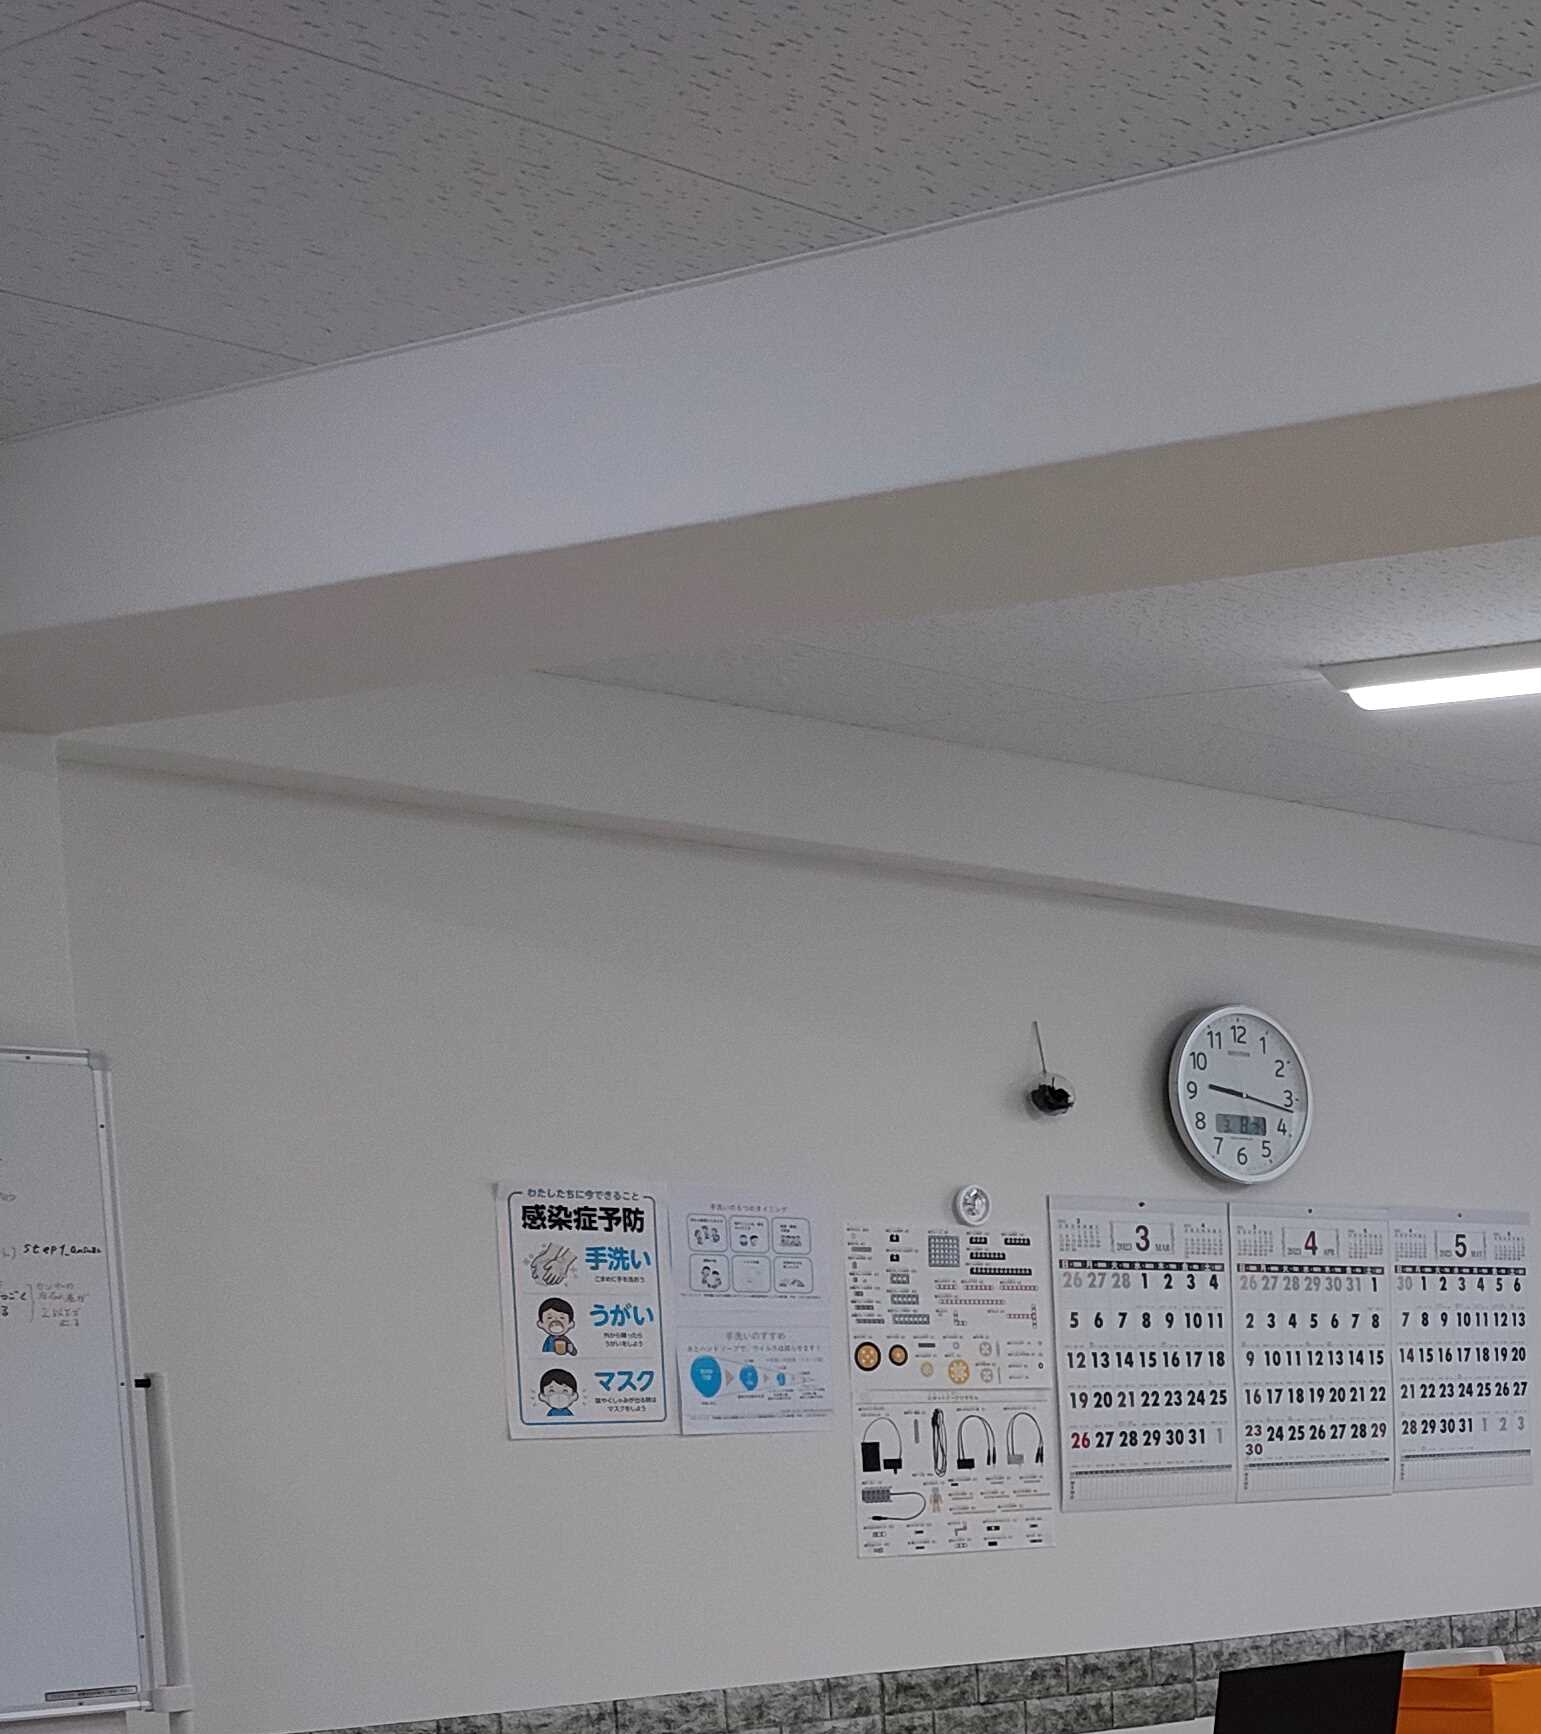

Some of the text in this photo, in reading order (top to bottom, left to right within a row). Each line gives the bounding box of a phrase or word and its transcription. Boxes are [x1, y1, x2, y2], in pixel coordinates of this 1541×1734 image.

[1207, 1031, 1222, 1049] 11
[1231, 1026, 1247, 1044] 12
[1260, 1037, 1267, 1054] 1
[1190, 1052, 1207, 1070] 10
[1275, 1060, 1284, 1077] 2
[1187, 1081, 1197, 1099] 9
[1284, 1090, 1293, 1108] 3
[1196, 1112, 1206, 1129] 8
[1277, 1119, 1287, 1135] 4
[1214, 1137, 1223, 1154] 7
[1262, 1141, 1271, 1158] 5
[1237, 1148, 1248, 1165] 6
[527, 1188, 640, 1201] わたしたちに今できること
[521, 1204, 645, 1233] 感染症予防
[1135, 1224, 1150, 1252] 3
[1304, 1230, 1318, 1256] 4
[1455, 1234, 1467, 1258] 5
[585, 1246, 652, 1271] 手洗い
[1062, 1272, 1218, 1290] 26 27 28 1 2 3 4
[1240, 1276, 1376, 1292] 26 27 28 29 30 31 1
[1396, 1276, 1520, 1292] 30 1 2 3 4 5 6
[589, 1304, 654, 1328] うがい
[1070, 1312, 1222, 1328] 5 6 7 8 9 10 11
[1246, 1313, 1379, 1328] 2 3 4 5 6 7 8
[1402, 1312, 1525, 1326] 7 8 9 10 11 12 13
[1068, 1351, 1225, 1368] 12 13 14 15 16 17 18
[1246, 1350, 1384, 1366] 9 10 11 12 13 14 15
[1400, 1347, 1526, 1362] 14 15 16 17 18 19 20
[594, 1370, 654, 1392] マスク
[1246, 1386, 1386, 1404] 16 17 18 19 20 21 22
[1401, 1382, 1527, 1398] 21 22 23 24 25 26 27
[1070, 1390, 1227, 1408] 19 20 21 22 23 24 25
[1246, 1423, 1386, 1441] 23 24 25 26 27 28 29
[1402, 1416, 1524, 1434] 28 29 30 31 1 2 3
[1072, 1428, 1222, 1448] 26 27 28 29 30 31 1
[1246, 1444, 1262, 1455] 30
